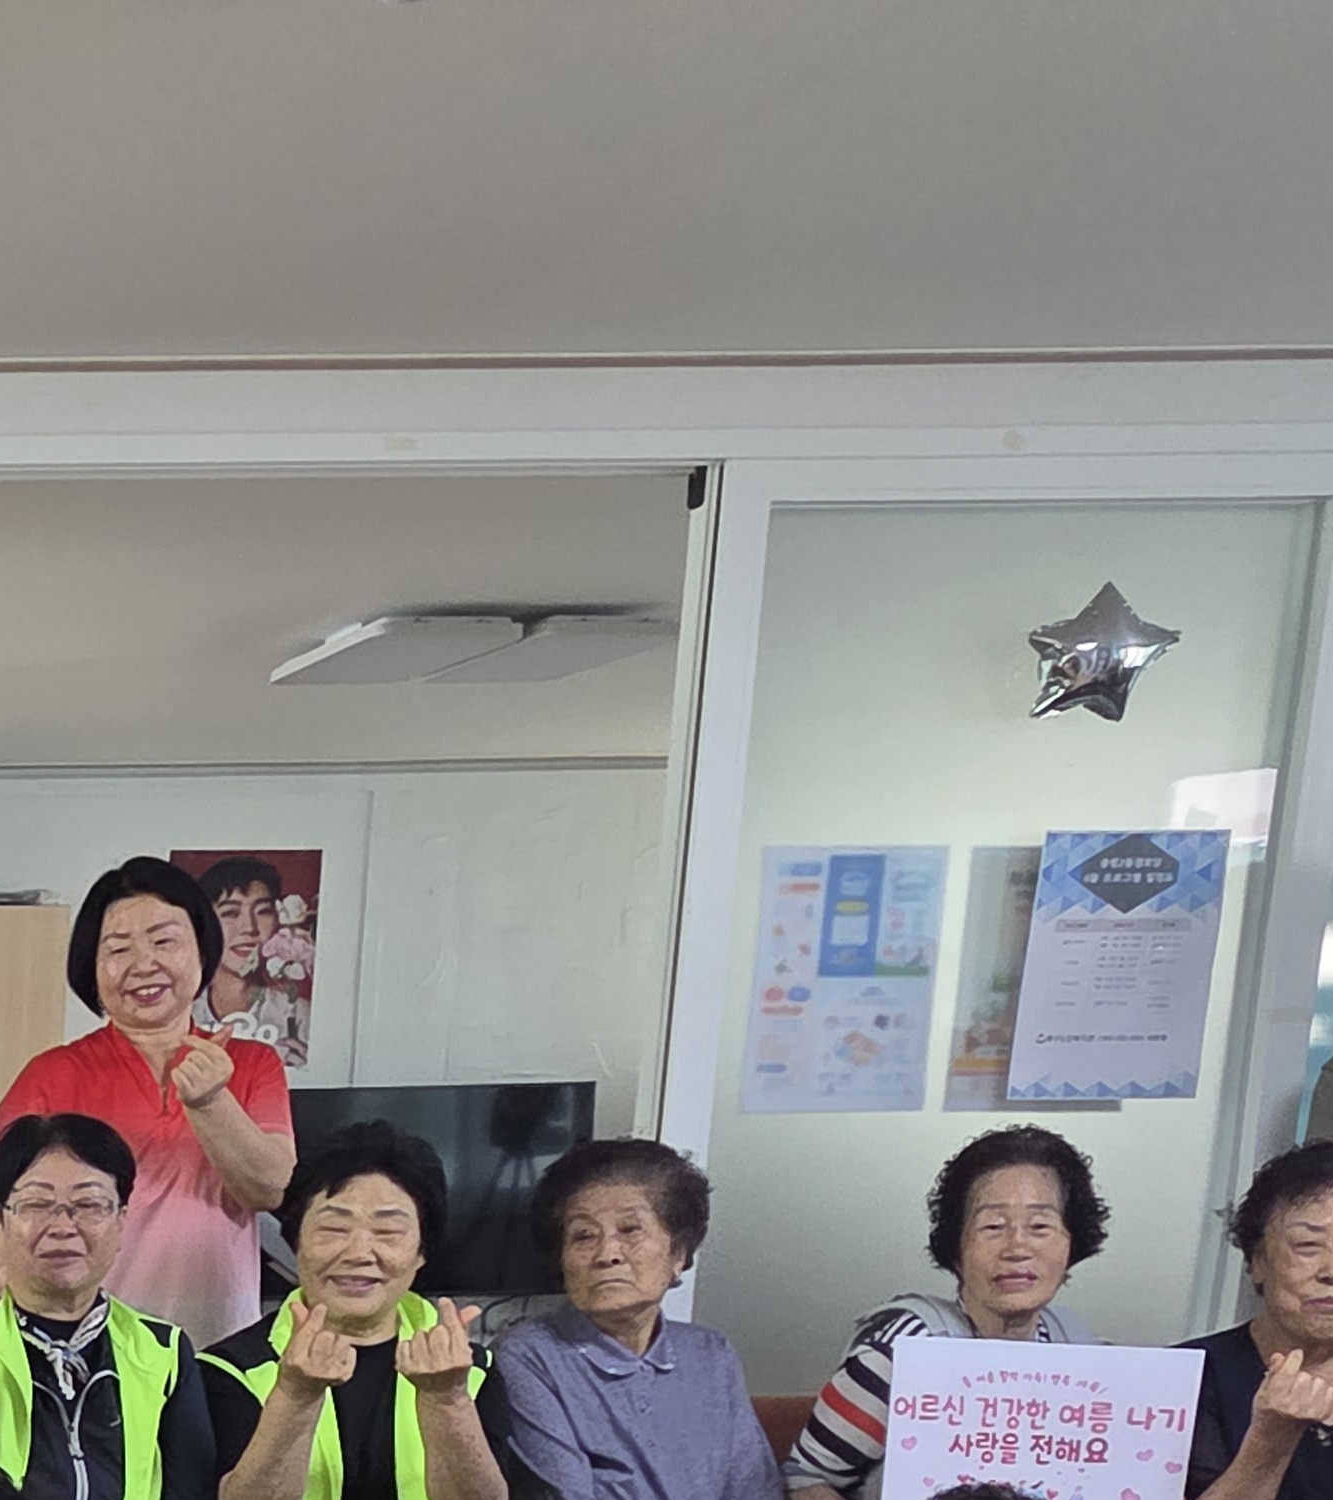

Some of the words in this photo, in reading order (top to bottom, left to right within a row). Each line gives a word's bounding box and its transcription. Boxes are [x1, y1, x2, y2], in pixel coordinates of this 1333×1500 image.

[893, 1394, 965, 1427] 어르신
[975, 1396, 1050, 1431] 건강한
[1058, 1401, 1114, 1434] 여름
[1126, 1406, 1186, 1432] 나기
[948, 1432, 1020, 1465] 사랑을
[1029, 1434, 1109, 1466] 전해요
